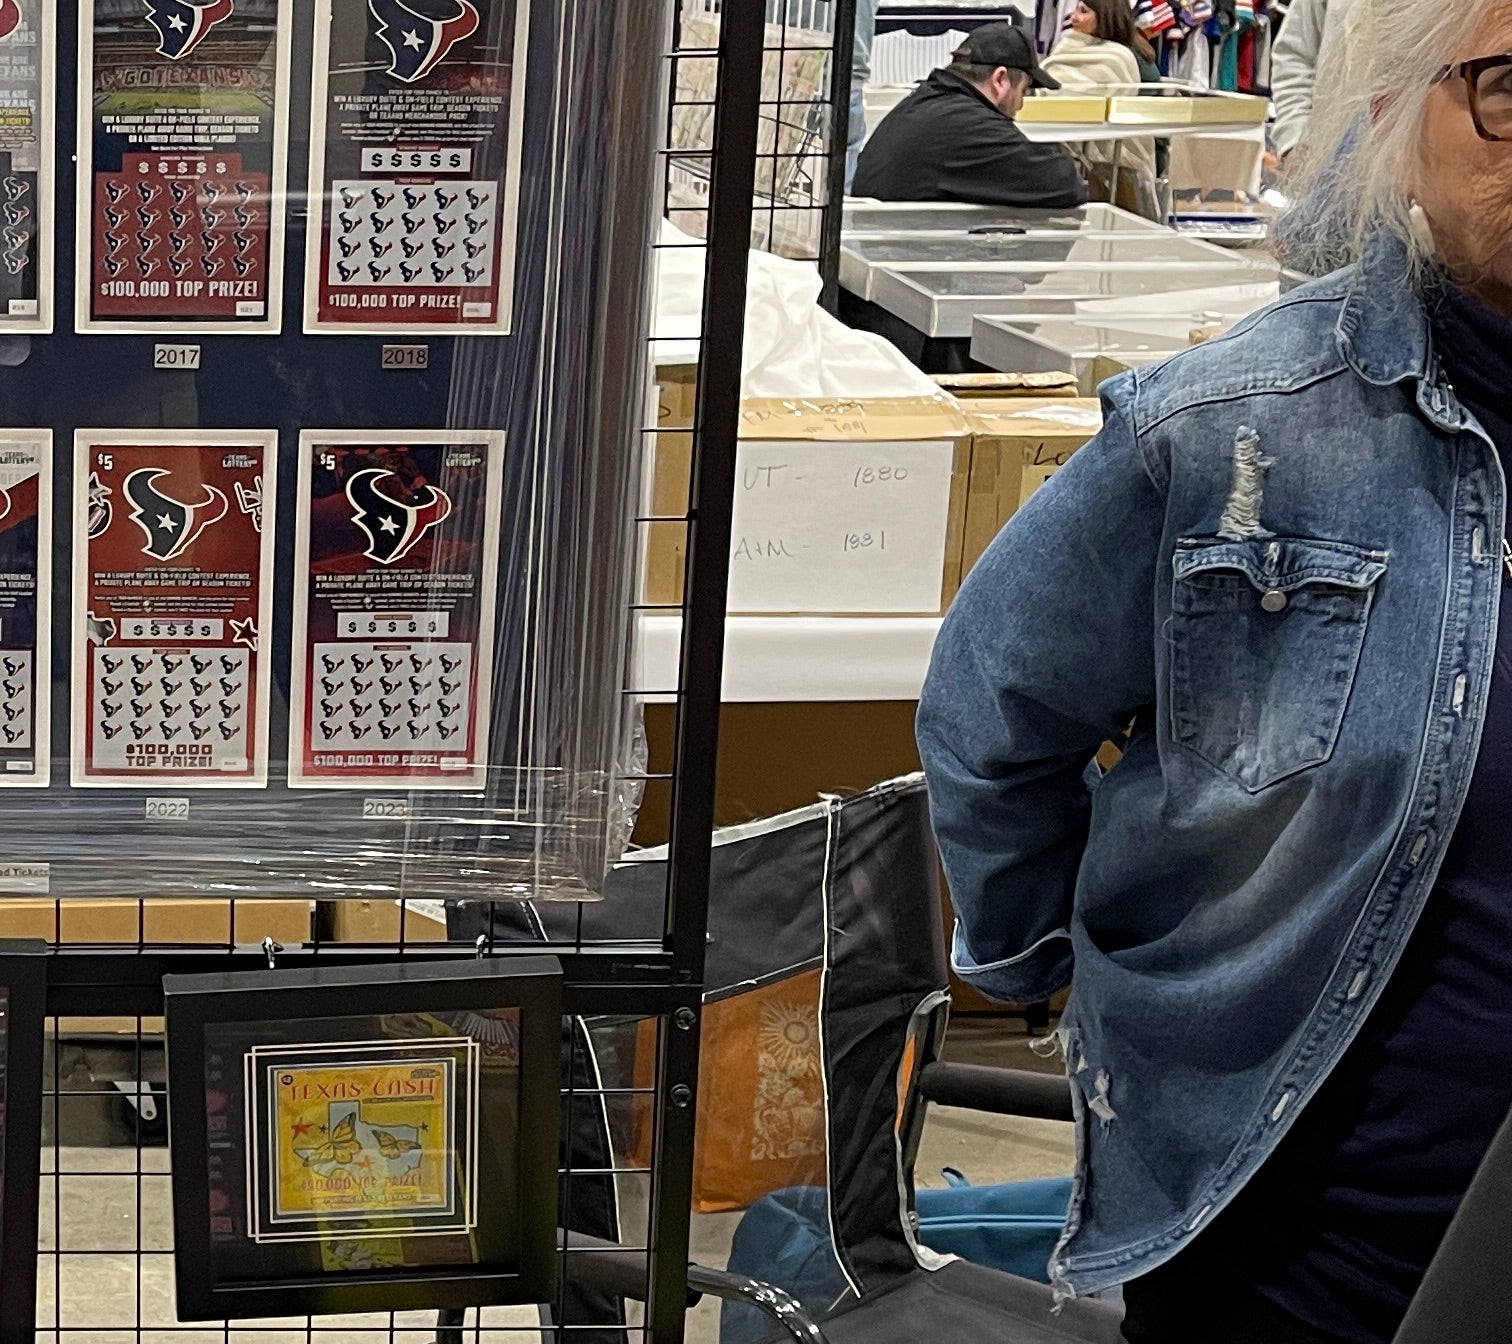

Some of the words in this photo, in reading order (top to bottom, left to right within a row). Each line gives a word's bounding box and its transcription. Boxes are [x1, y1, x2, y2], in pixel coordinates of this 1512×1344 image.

[101, 281, 170, 297] $100,000
[175, 281, 204, 297] TOP
[208, 281, 258, 297] PRIZE!
[329, 294, 387, 309] $100,000
[391, 294, 416, 308] TOP
[419, 294, 461, 309] PRIZE!
[157, 349, 199, 364] 2017
[384, 349, 426, 365] 2018
[98, 453, 113, 470] $5
[320, 453, 336, 470] $5
[742, 465, 788, 491] UT
[853, 466, 909, 489] 1880
[125, 756, 160, 767] TOP
[161, 756, 213, 767] PRIZE!
[147, 801, 188, 817] 2022
[291, 1082, 361, 1101] TEXAS
[373, 1079, 434, 1097] CASH
